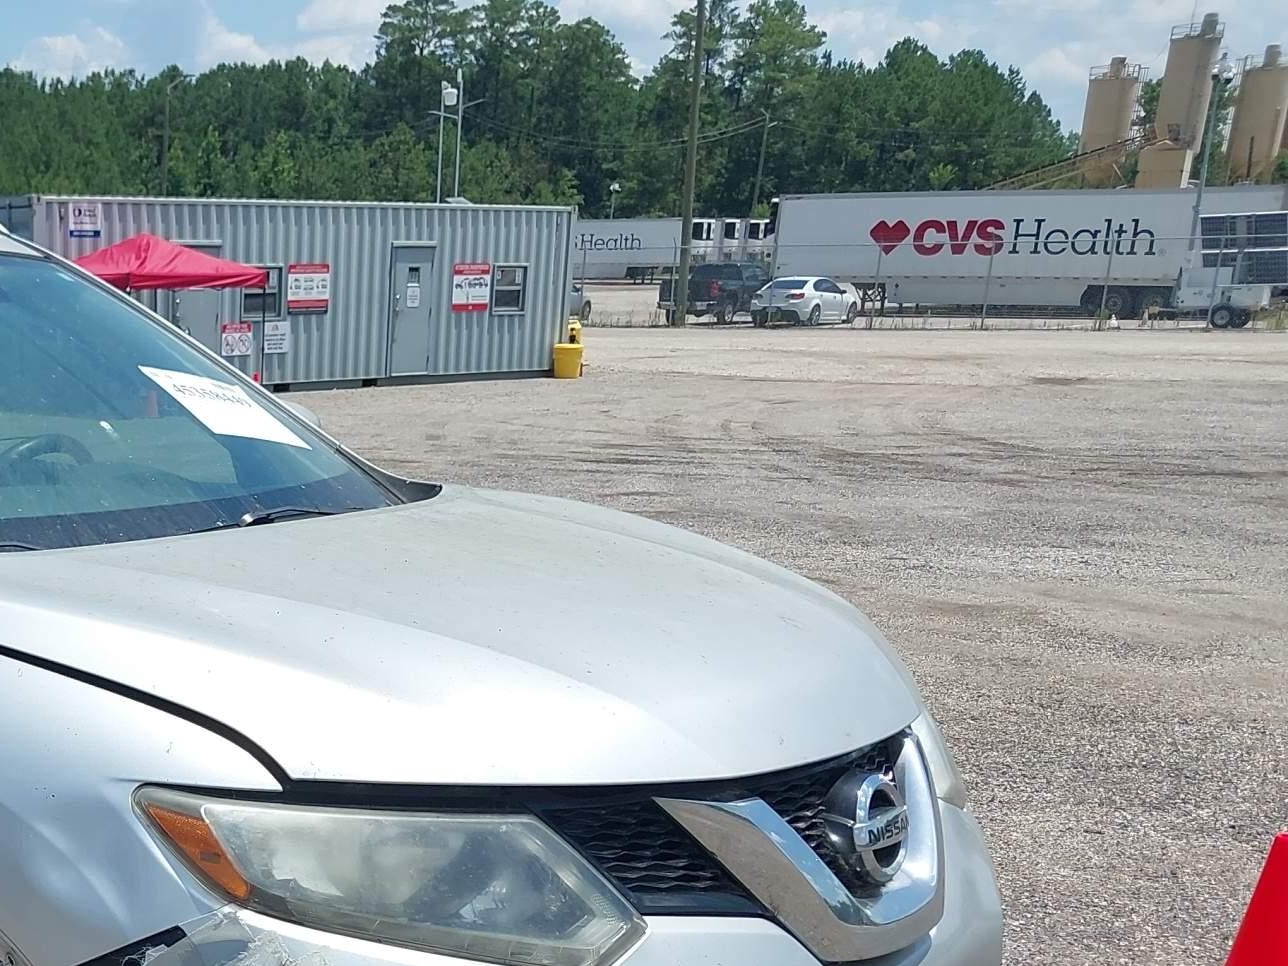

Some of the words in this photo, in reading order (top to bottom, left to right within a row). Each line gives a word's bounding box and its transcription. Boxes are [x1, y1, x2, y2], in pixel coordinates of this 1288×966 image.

[579, 232, 642, 251] Health
[913, 219, 1005, 256] CVS
[1008, 218, 1157, 256] Health
